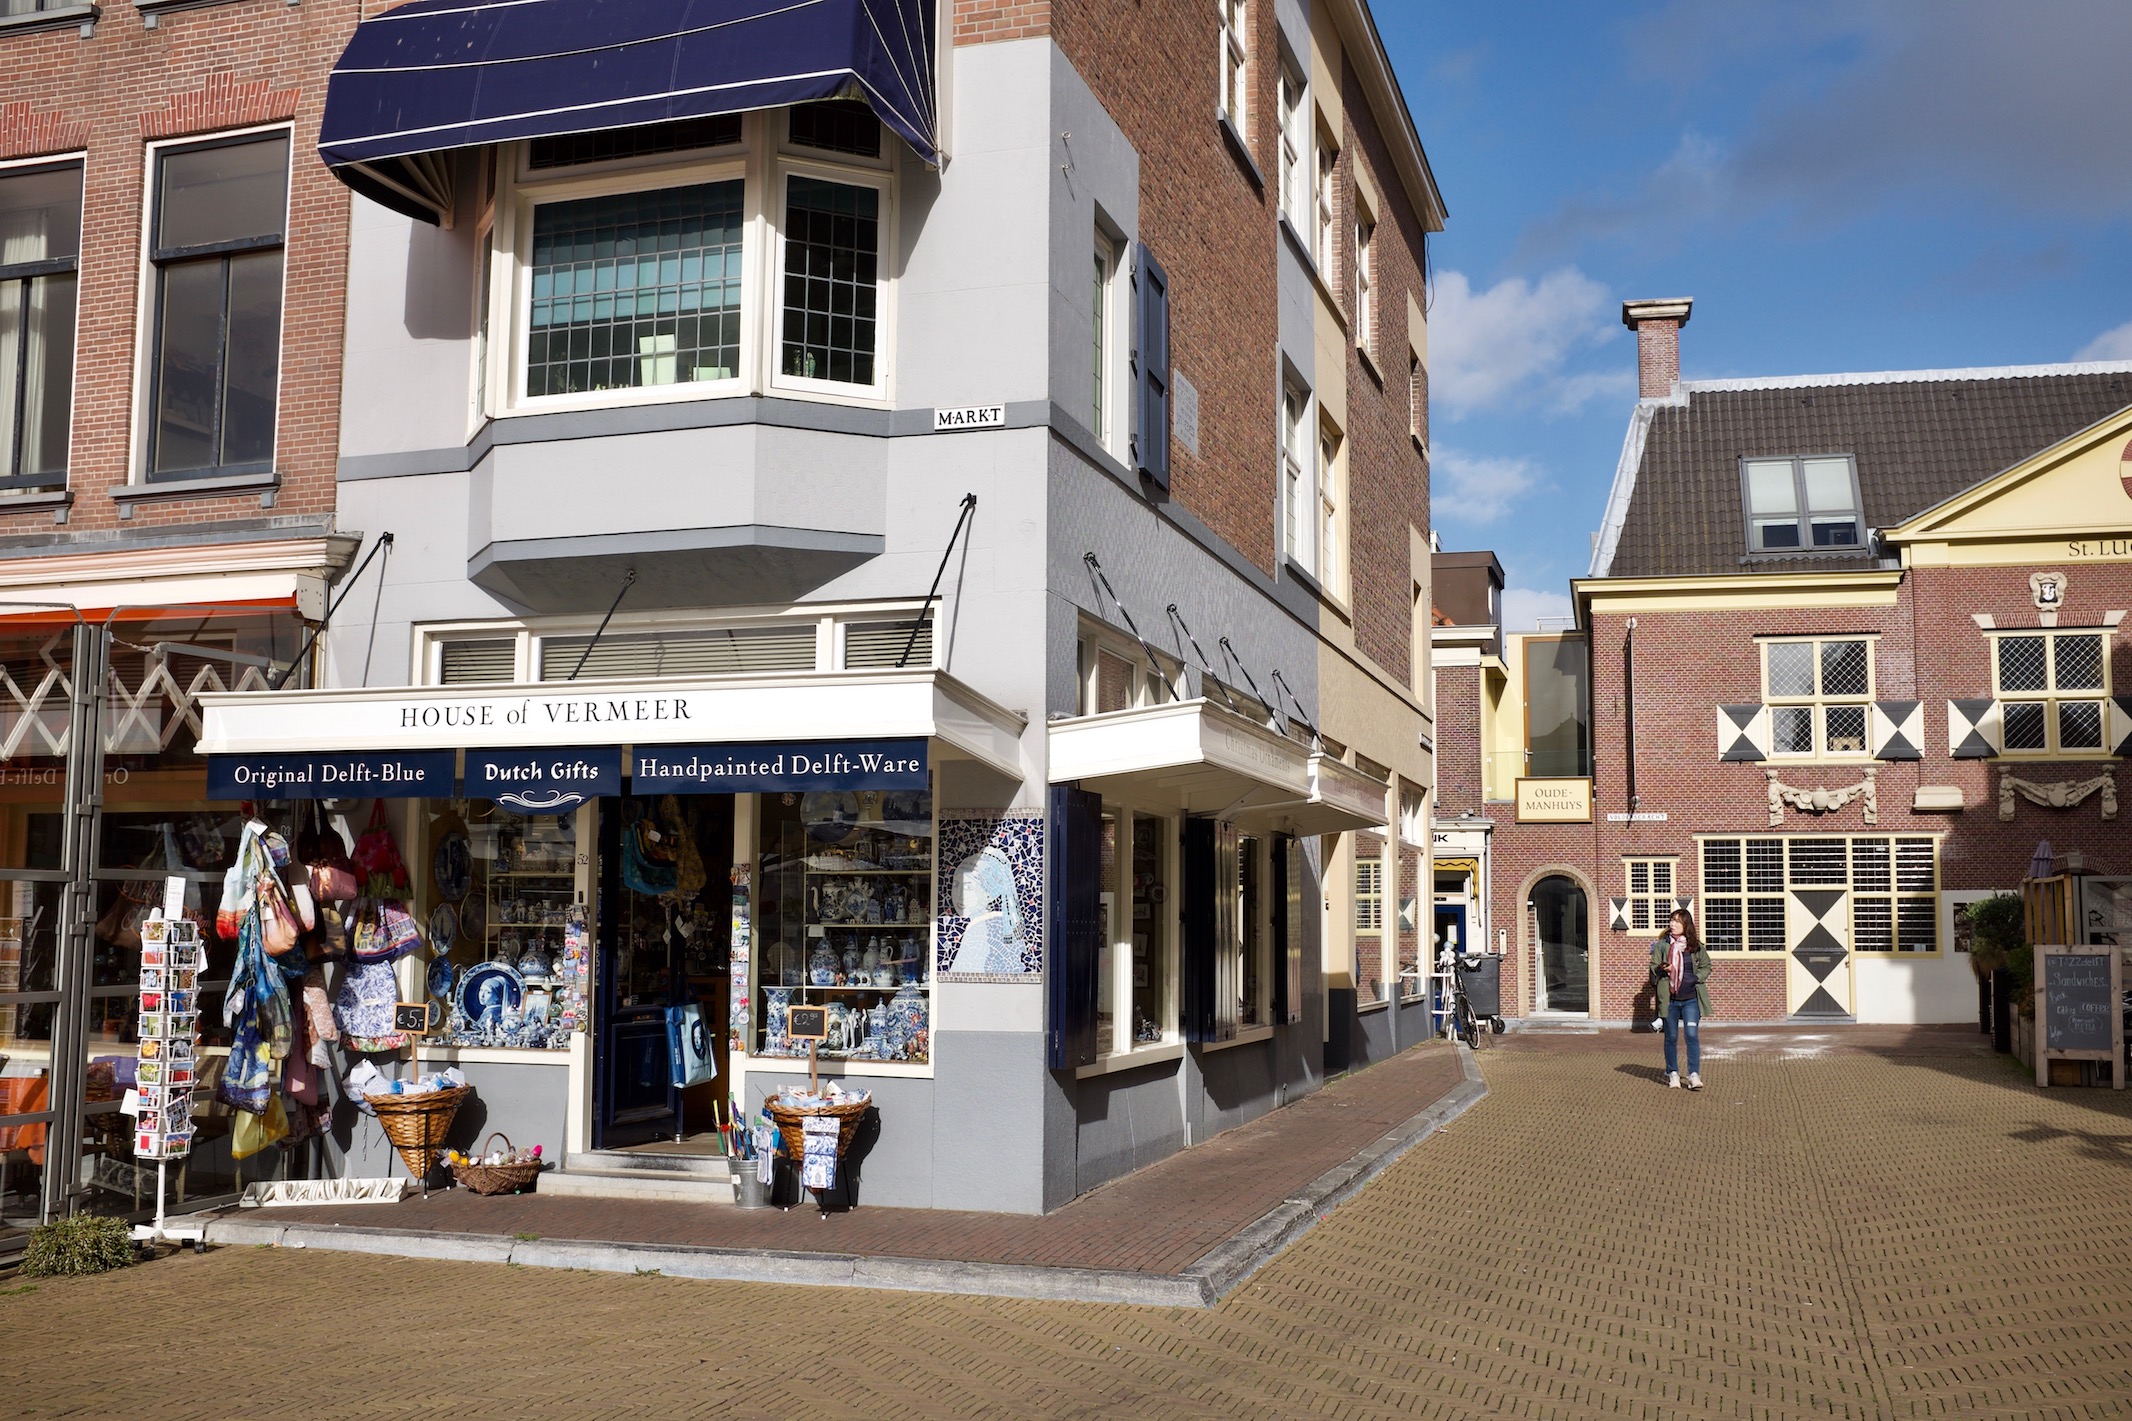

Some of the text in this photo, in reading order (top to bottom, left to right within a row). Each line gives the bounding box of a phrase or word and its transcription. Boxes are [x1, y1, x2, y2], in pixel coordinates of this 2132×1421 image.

[938, 408, 1001, 426] MARKT
[2068, 540, 2132, 557] St. LU
[399, 698, 693, 728] HOUSE of VERMEER
[1225, 727, 1259, 762] Christmas
[233, 762, 426, 789] Original Delft-Blue
[483, 759, 600, 781] Dutch Gifts
[639, 752, 921, 783] Handpainted Delft-Ware
[1525, 800, 1583, 810] MANHUYS
[576, 853, 589, 865] 52
